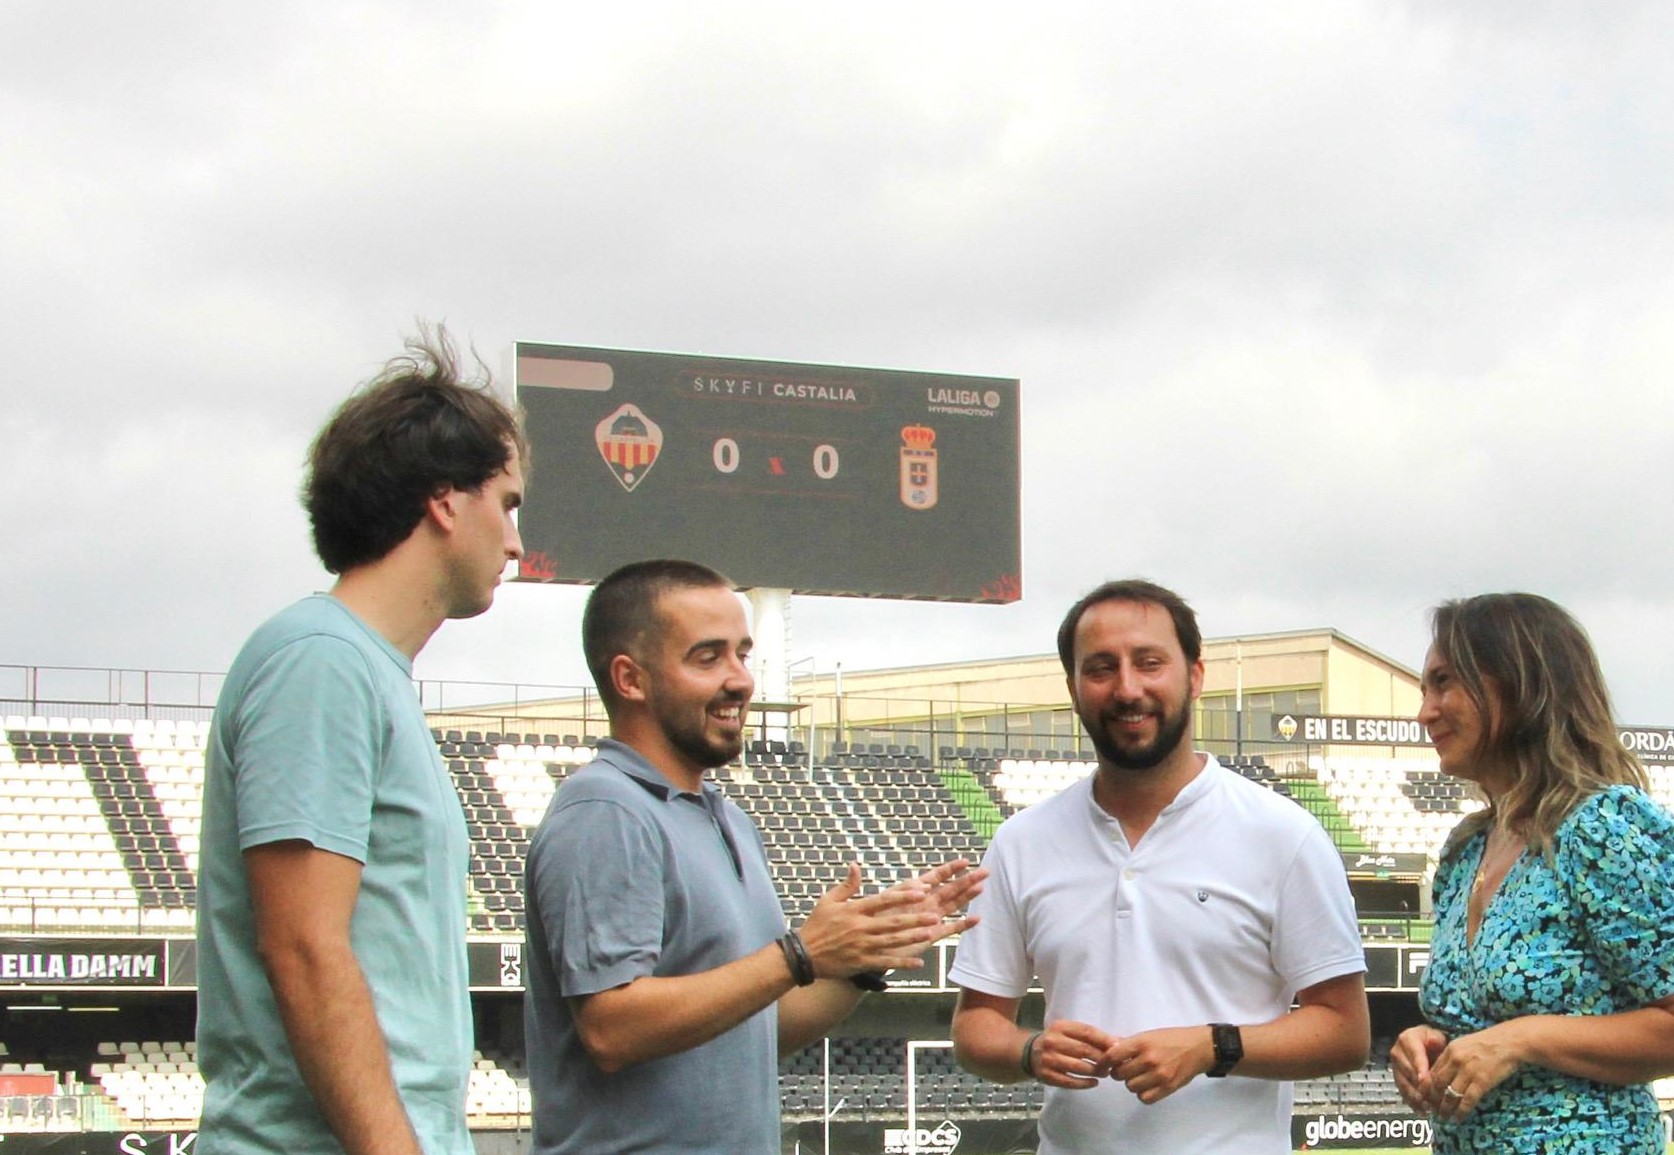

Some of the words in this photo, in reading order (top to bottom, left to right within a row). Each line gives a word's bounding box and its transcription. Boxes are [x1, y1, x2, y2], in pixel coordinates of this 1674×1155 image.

[773, 383, 857, 401] CASTALIA
[927, 387, 981, 406] LALIGA
[712, 438, 740, 474] 0
[813, 444, 839, 479] 0
[1304, 718, 1327, 740] EN
[1331, 719, 1352, 741] EL
[1355, 720, 1421, 743] ESCUDO
[1, 954, 66, 978] ELLA
[71, 954, 157, 978] DAMM
[1305, 1114, 1433, 1146] globeenergy
